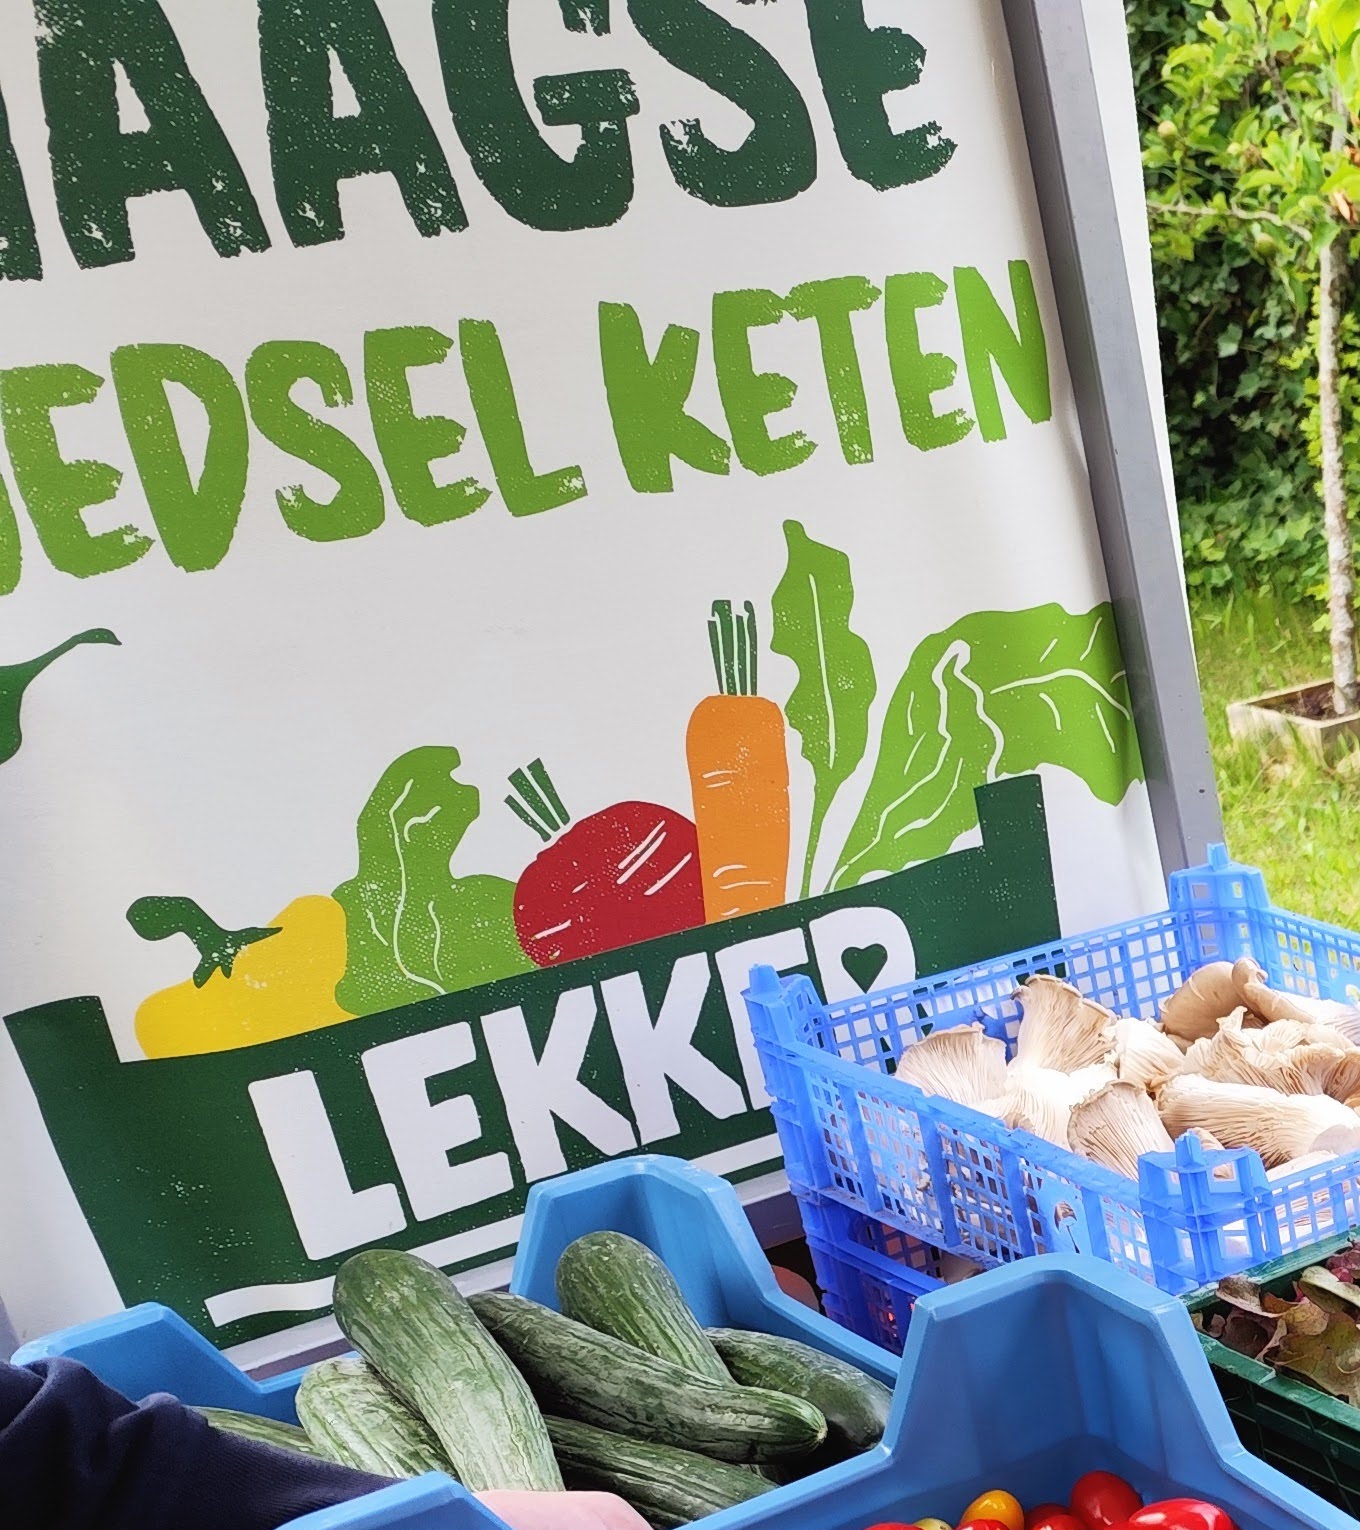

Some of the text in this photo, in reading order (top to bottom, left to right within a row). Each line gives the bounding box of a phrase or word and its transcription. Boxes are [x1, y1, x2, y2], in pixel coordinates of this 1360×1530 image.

[0, 0, 956, 281] AAGSE
[0, 258, 1053, 595] EDSEL KETEN
